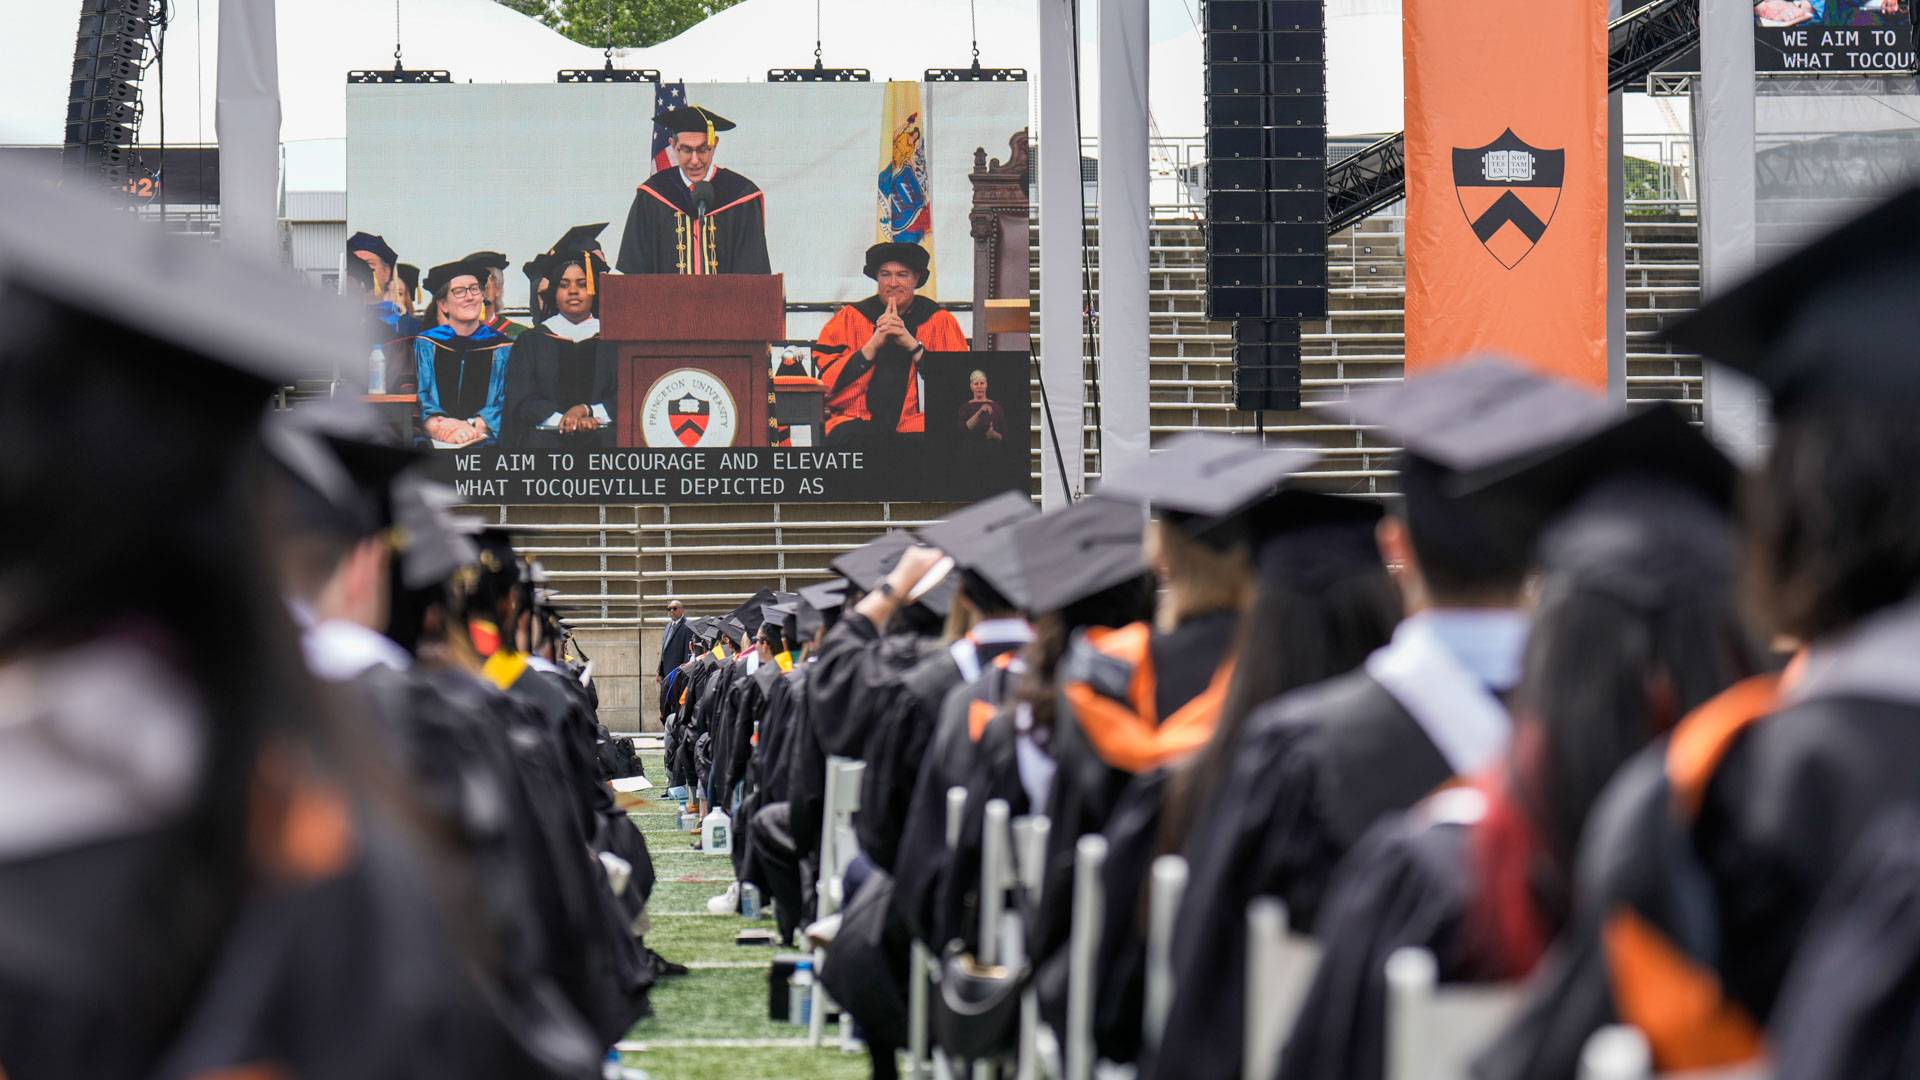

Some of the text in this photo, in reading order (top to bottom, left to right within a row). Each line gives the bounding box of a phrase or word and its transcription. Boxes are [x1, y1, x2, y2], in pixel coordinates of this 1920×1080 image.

[1782, 30, 1897, 47] WE AIM TO
[1782, 52, 1834, 69] WHAT
[649, 378, 729, 428] PRINCETON UNIVERSITY
[455, 452, 864, 472] WE AIM TO ENCOURAGE AND ELEVATE
[455, 477, 825, 498] WHAT TOCQUEVILLE DEPICTED AS
